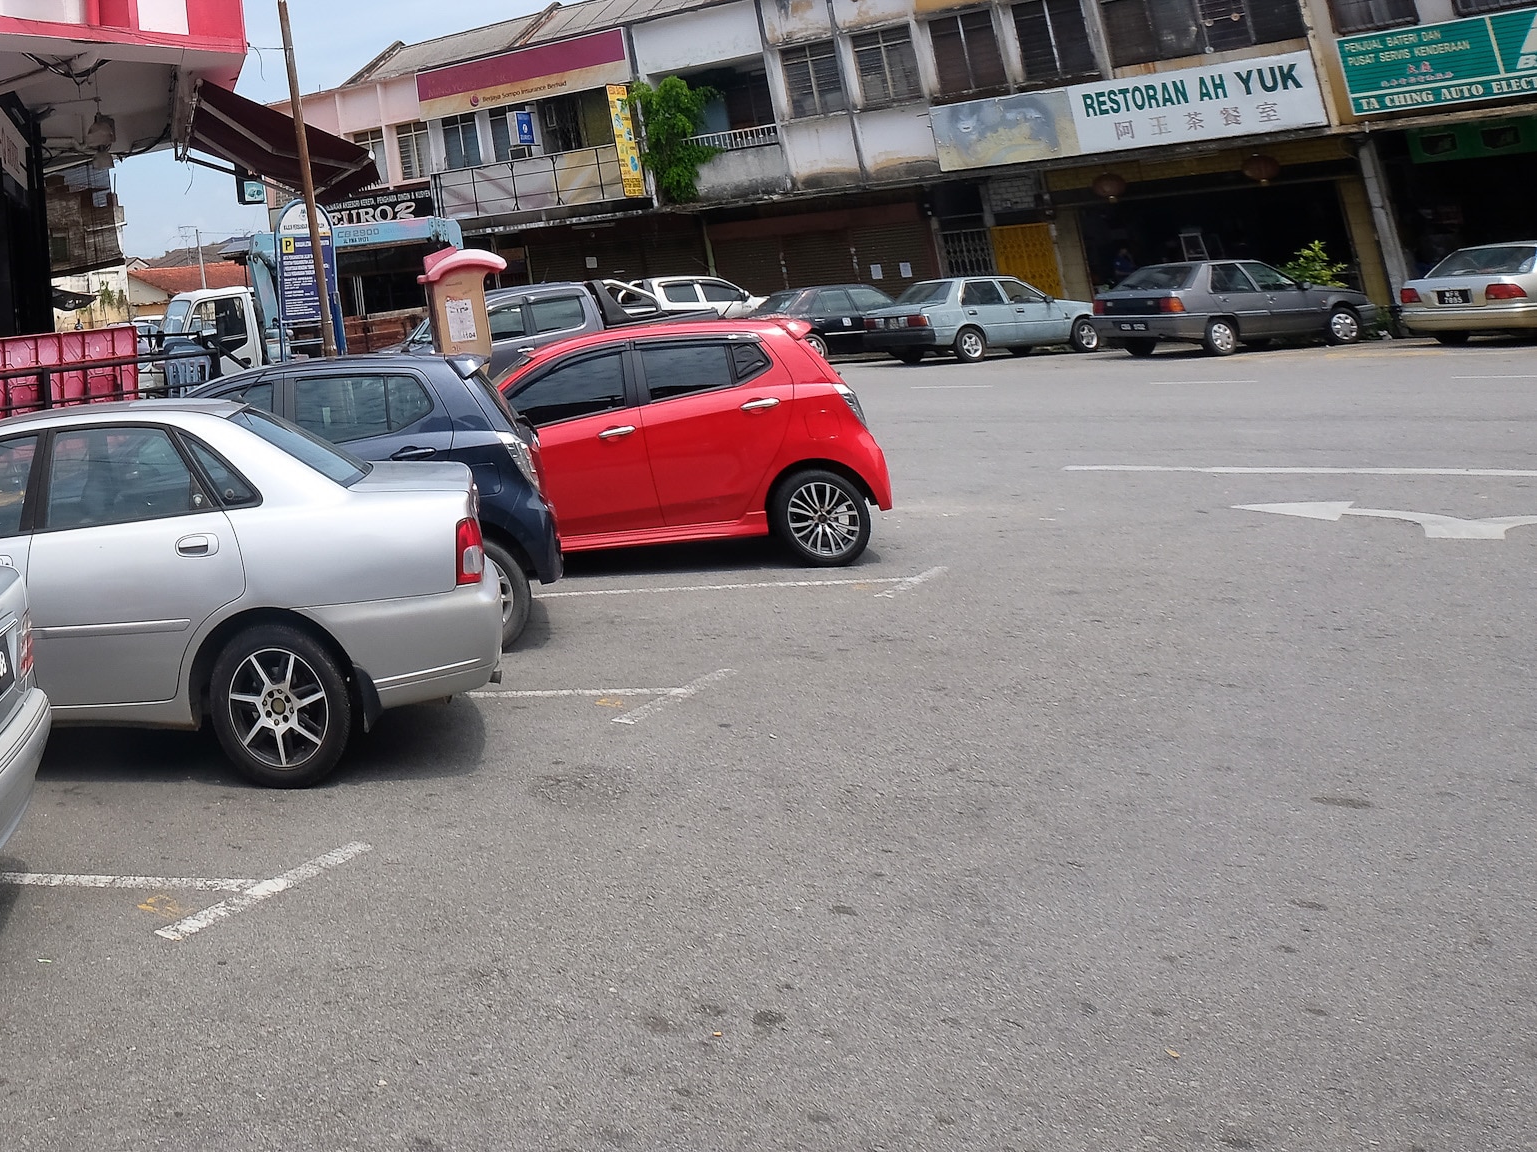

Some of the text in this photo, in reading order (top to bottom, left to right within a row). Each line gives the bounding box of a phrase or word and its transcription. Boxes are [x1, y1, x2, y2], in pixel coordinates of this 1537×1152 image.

[1344, 30, 1441, 53] PENJUAL BATERI DAN
[1347, 40, 1471, 67] PUSAT SERVIS KENDERAAN
[1081, 63, 1303, 118] RESTORAN AH YUK
[1358, 97, 1380, 110] TA
[1384, 90, 1434, 107] CHING
[1441, 84, 1484, 100] AUTO
[285, 240, 292, 251] P
